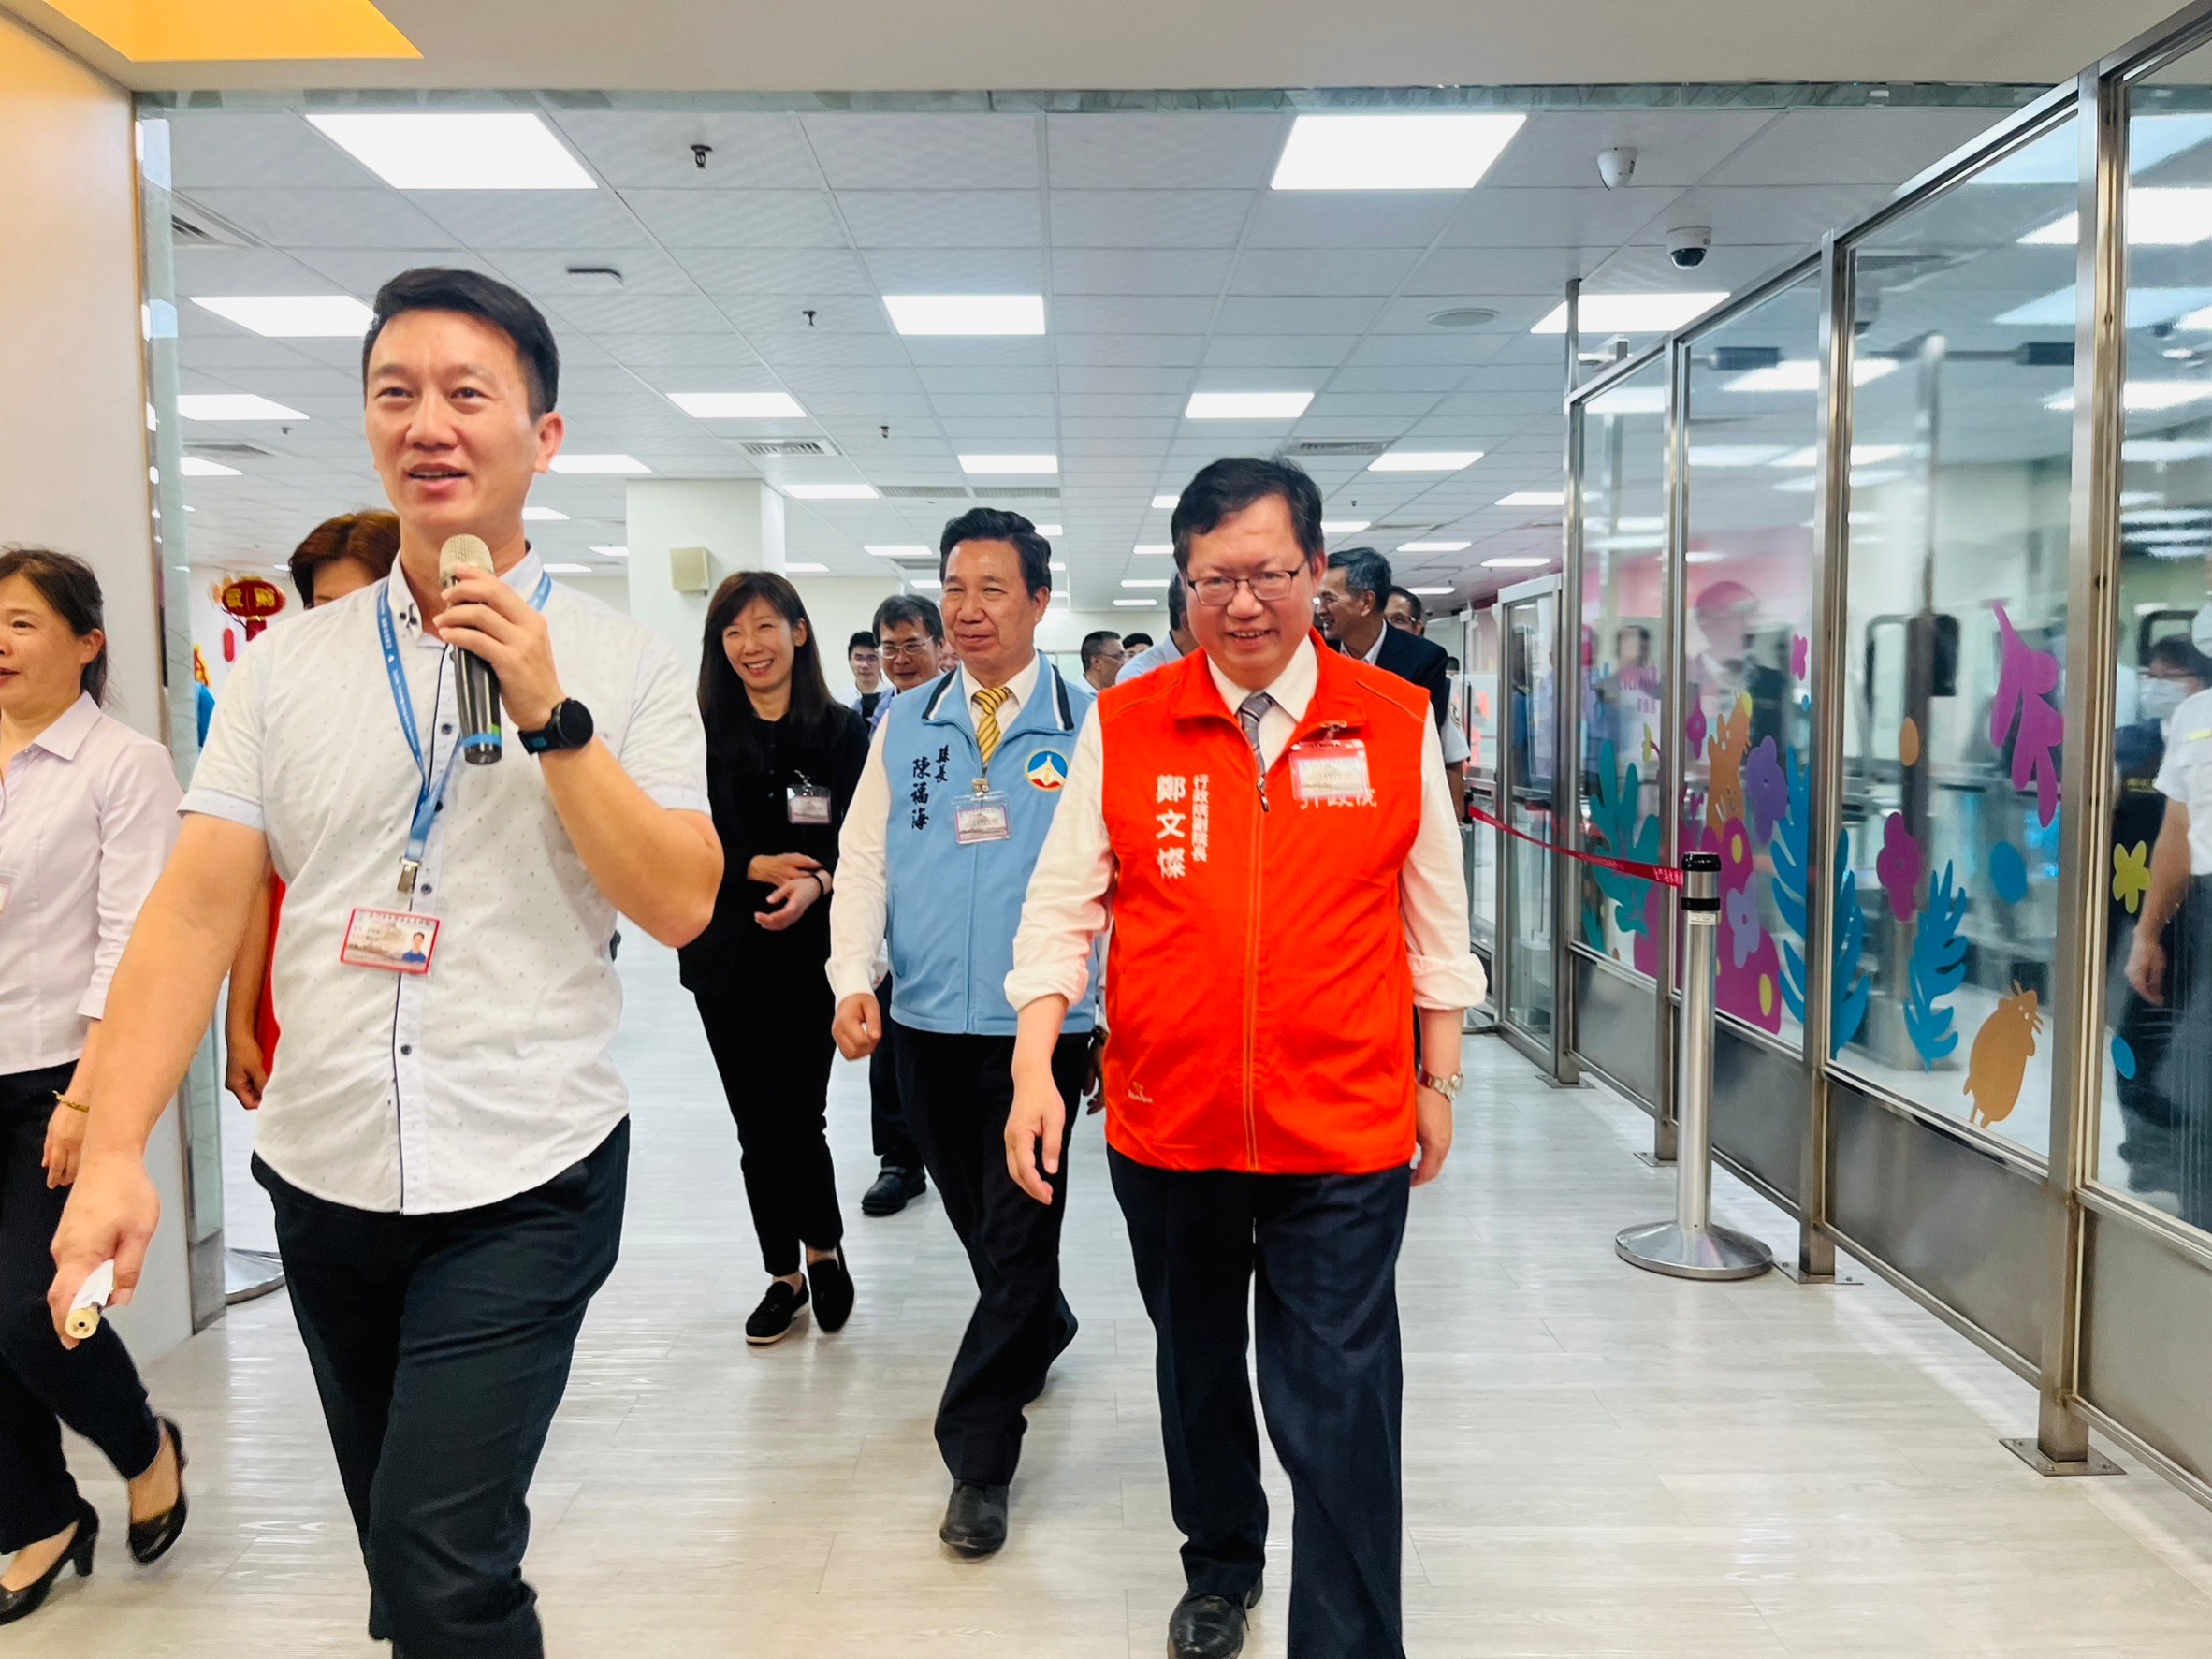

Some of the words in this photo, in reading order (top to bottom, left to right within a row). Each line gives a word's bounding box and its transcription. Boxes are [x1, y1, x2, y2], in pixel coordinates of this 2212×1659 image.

[910, 756, 932, 831] 陳福海
[1156, 774, 1186, 879] 鄭文燦
